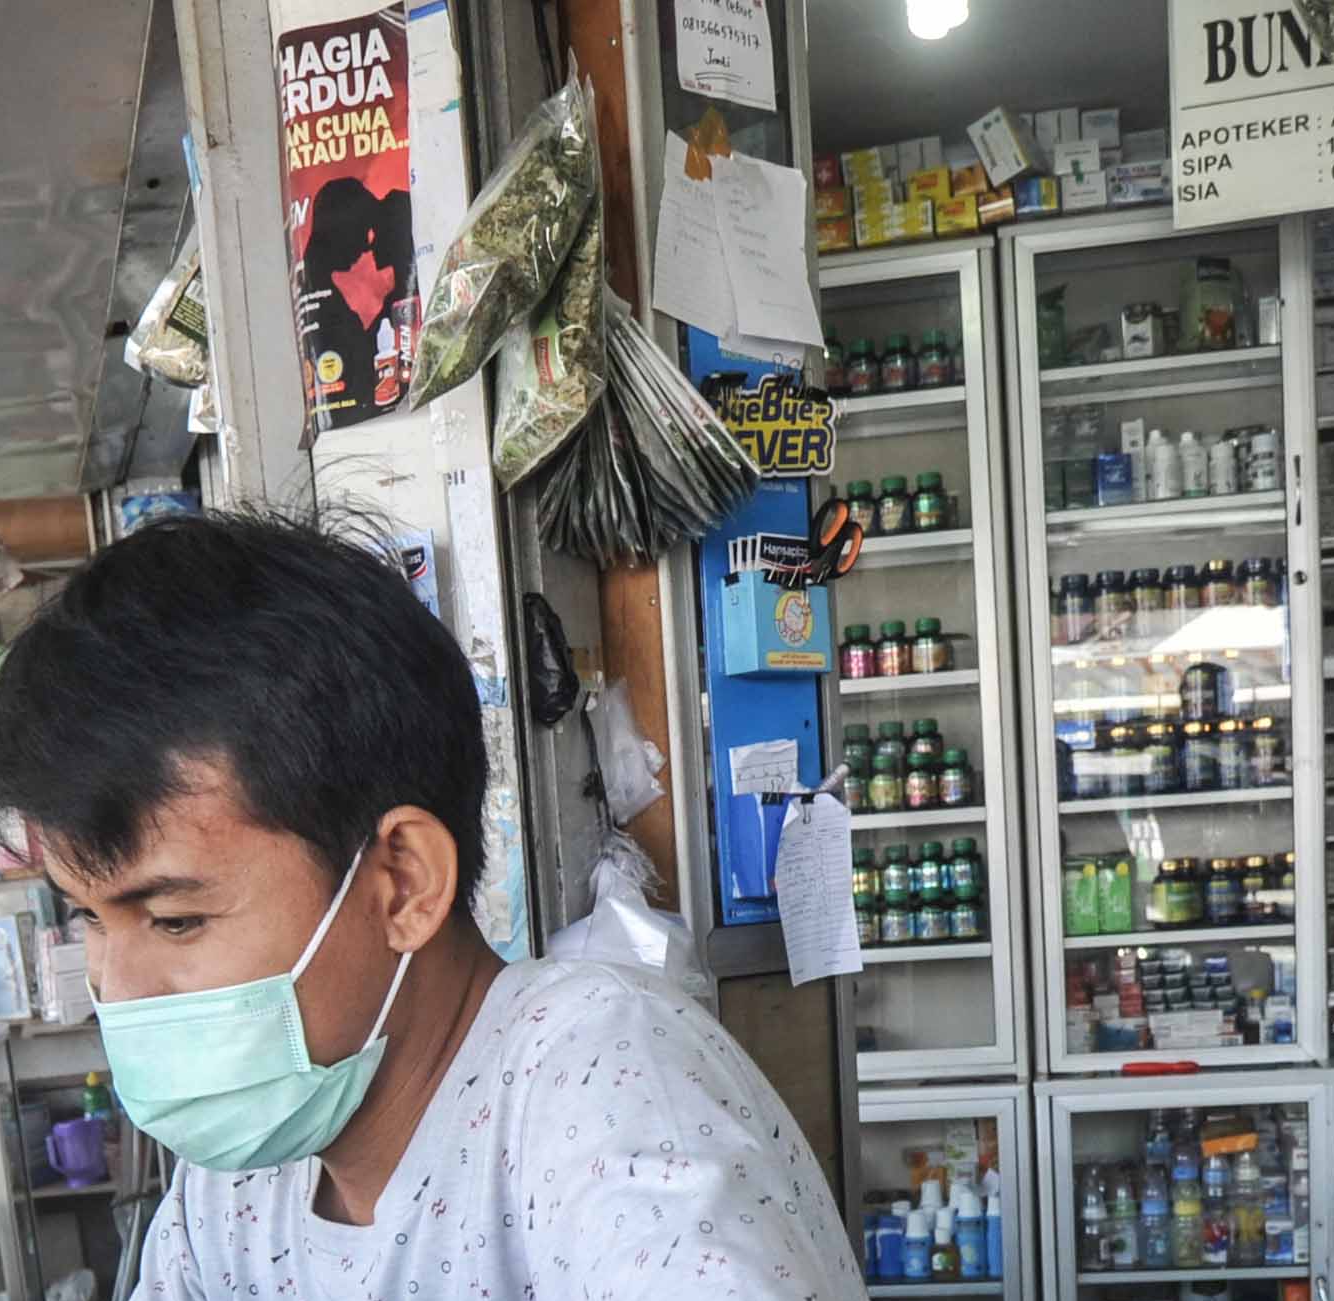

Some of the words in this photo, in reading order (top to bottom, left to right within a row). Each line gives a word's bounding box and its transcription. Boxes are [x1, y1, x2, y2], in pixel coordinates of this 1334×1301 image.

[317, 106, 390, 141] CUMA
[1181, 114, 1310, 149] APOTEKER
[290, 137, 347, 171] ATAU
[1182, 153, 1233, 177] SIPA
